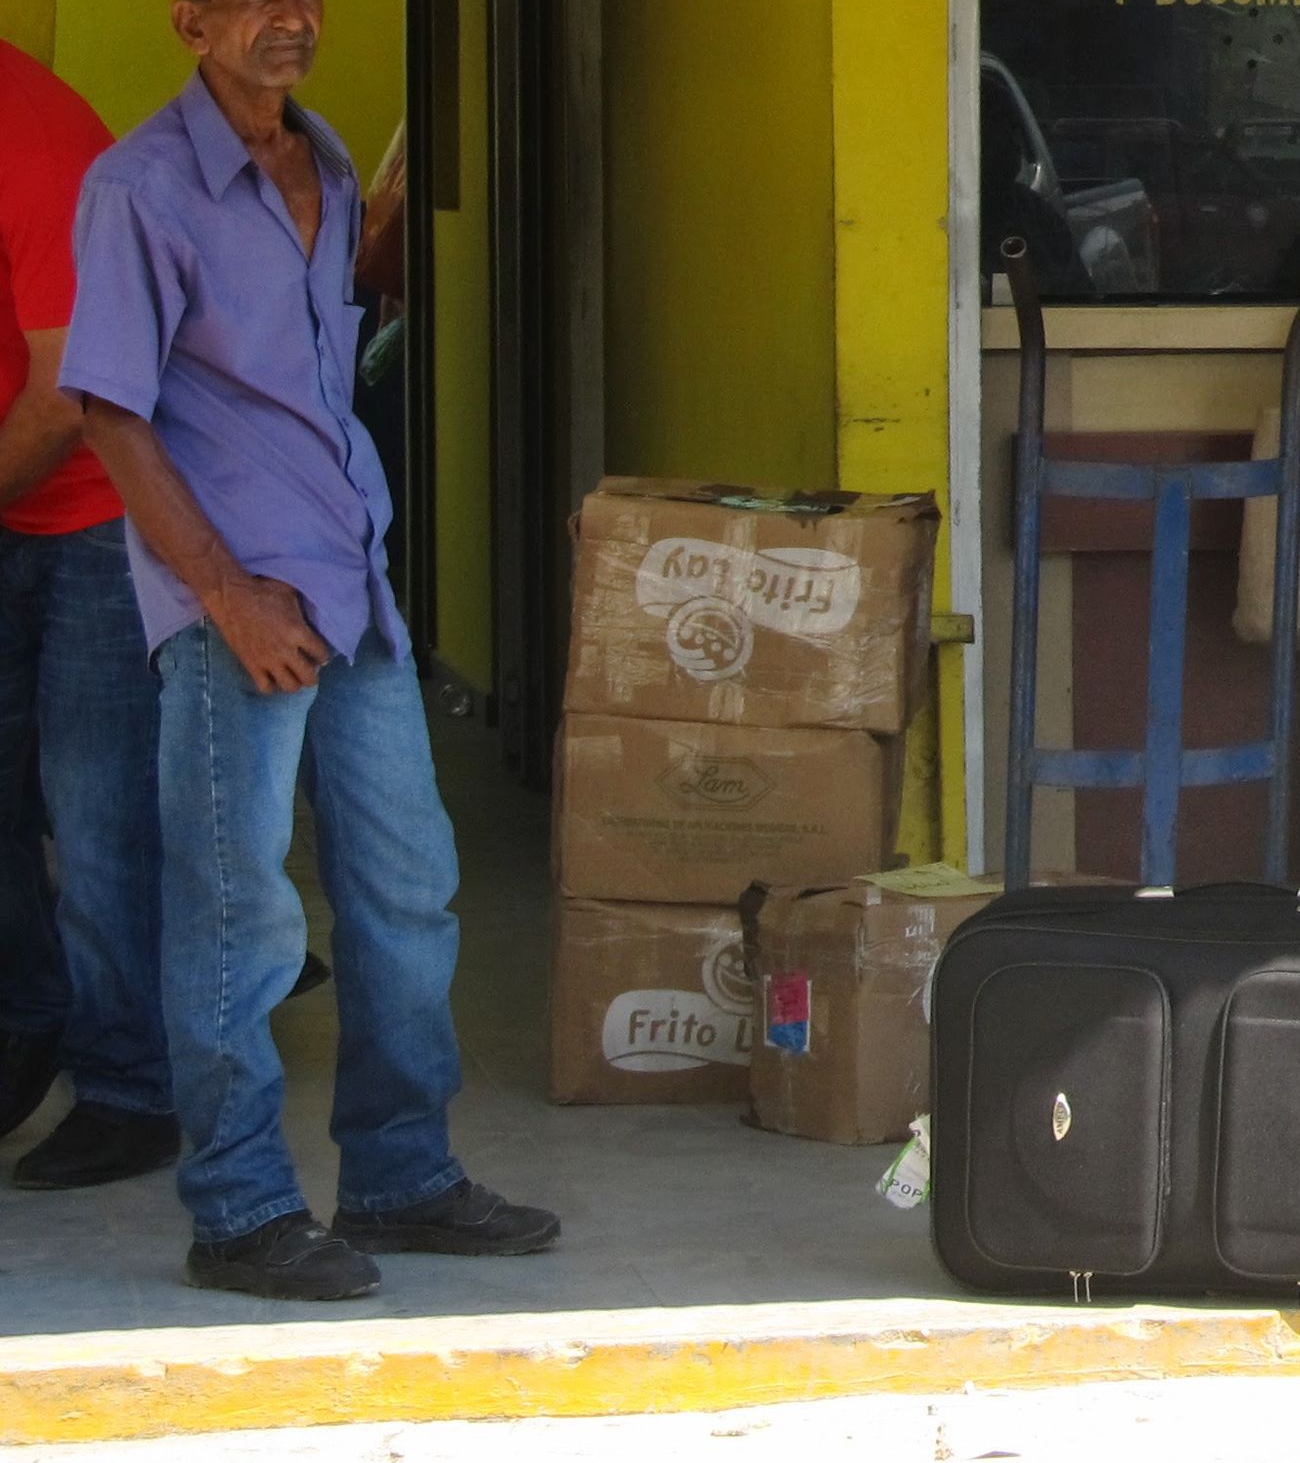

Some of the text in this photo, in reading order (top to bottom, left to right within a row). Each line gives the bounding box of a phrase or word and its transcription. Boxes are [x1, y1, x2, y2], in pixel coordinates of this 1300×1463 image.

[662, 545, 835, 614] Frito Lay
[628, 1009, 717, 1047] Frito
